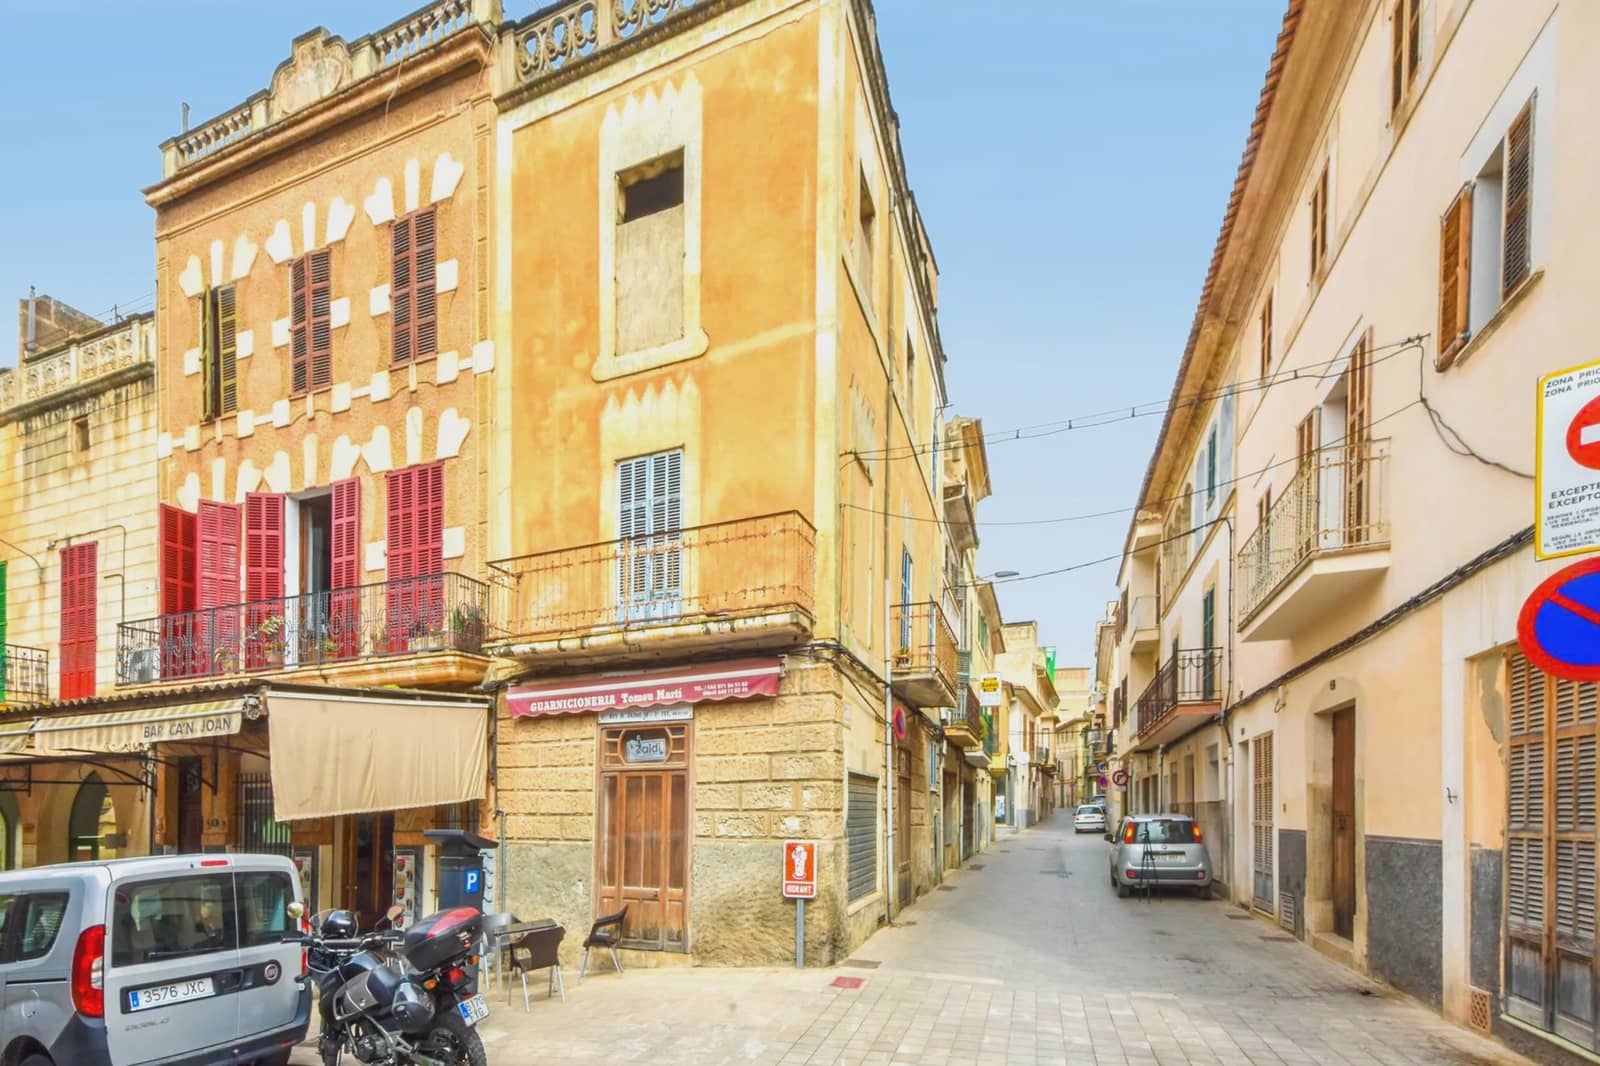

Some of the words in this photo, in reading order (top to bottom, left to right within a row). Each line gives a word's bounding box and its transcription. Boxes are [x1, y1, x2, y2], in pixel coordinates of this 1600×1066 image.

[1545, 385, 1572, 397] ZONA
[1546, 376, 1573, 388] ZONA
[530, 695, 616, 712] GUARNICIONERIA
[621, 691, 654, 704] Tomeu
[657, 687, 682, 701] Martí
[144, 725, 163, 739] BAR
[169, 722, 194, 736] CA'N
[202, 717, 231, 733] JOAN
[467, 872, 477, 890] P
[143, 985, 178, 1004] 3576
[182, 981, 206, 996] JXC
